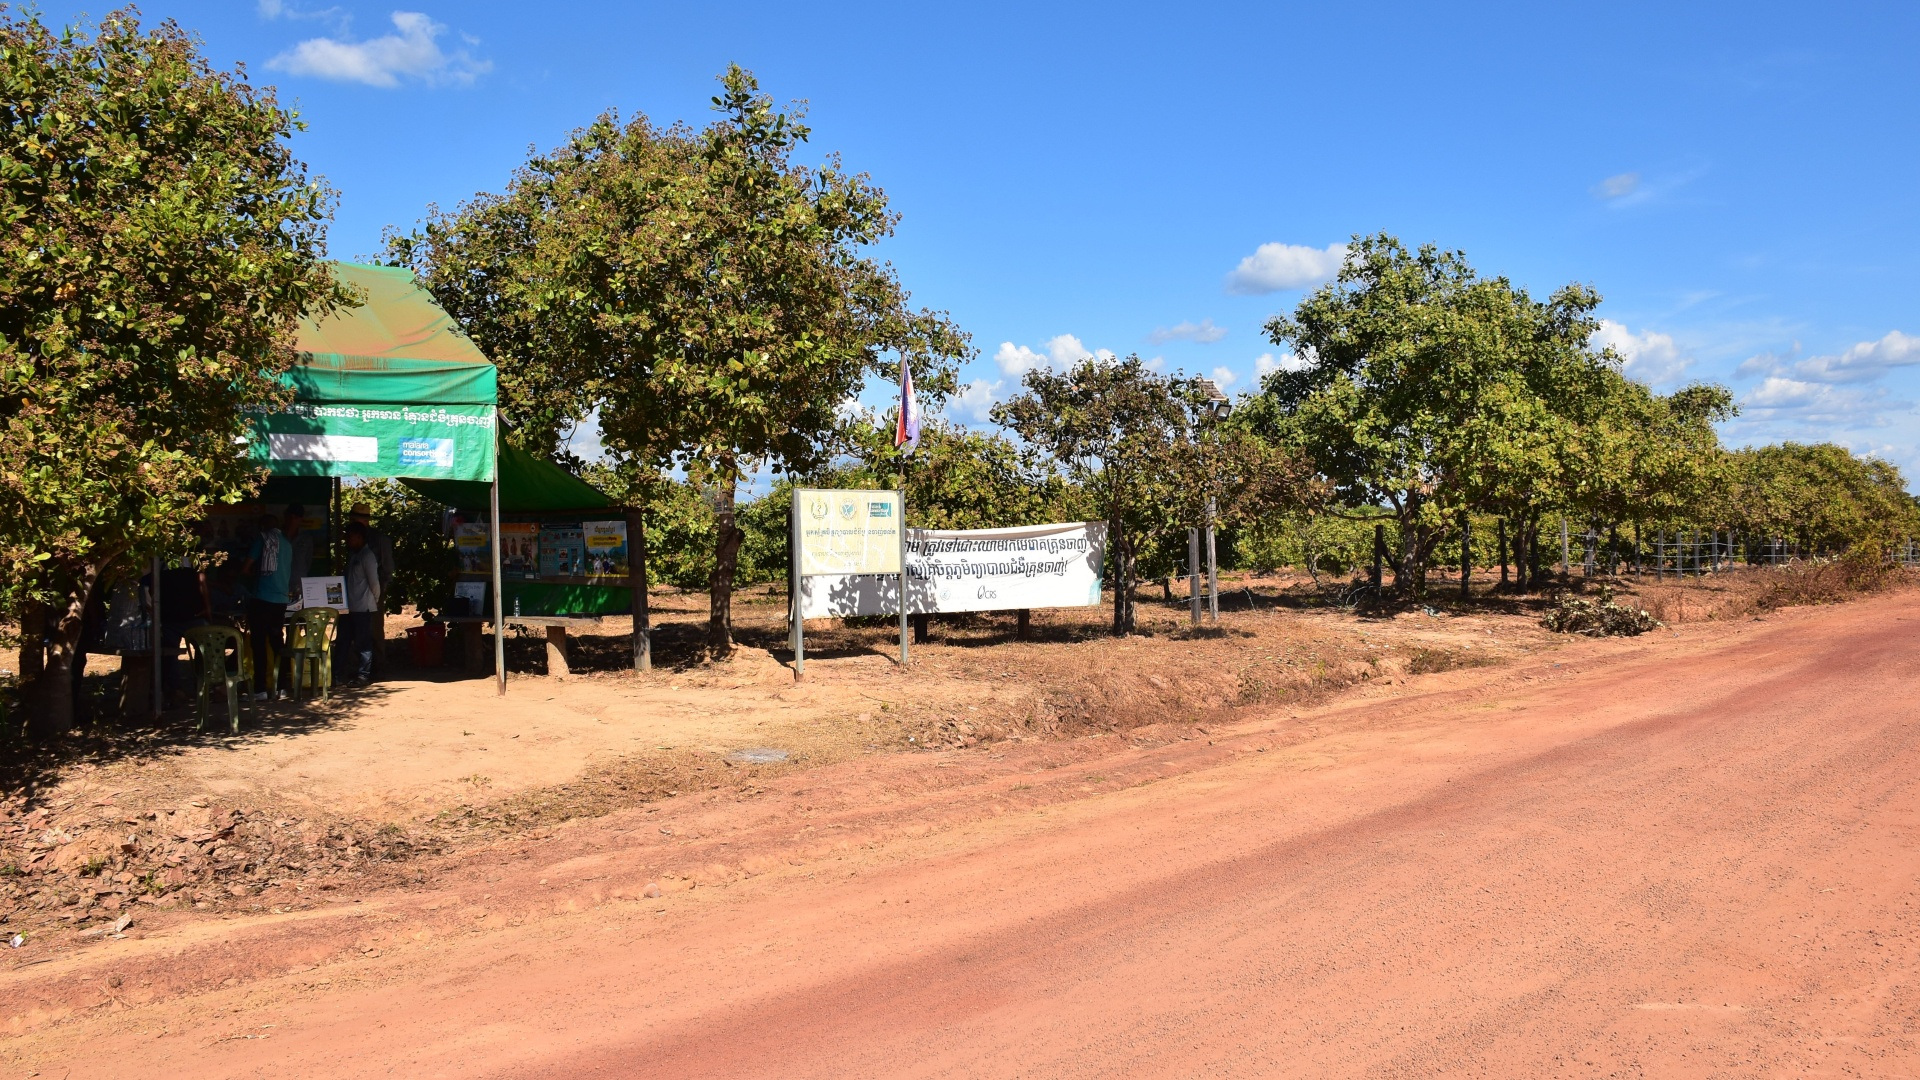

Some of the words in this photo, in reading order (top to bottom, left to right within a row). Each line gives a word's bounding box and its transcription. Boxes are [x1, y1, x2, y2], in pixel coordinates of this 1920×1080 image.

[403, 441, 429, 449] malaria
[403, 449, 446, 457] consorti
[985, 590, 997, 599] CRS
